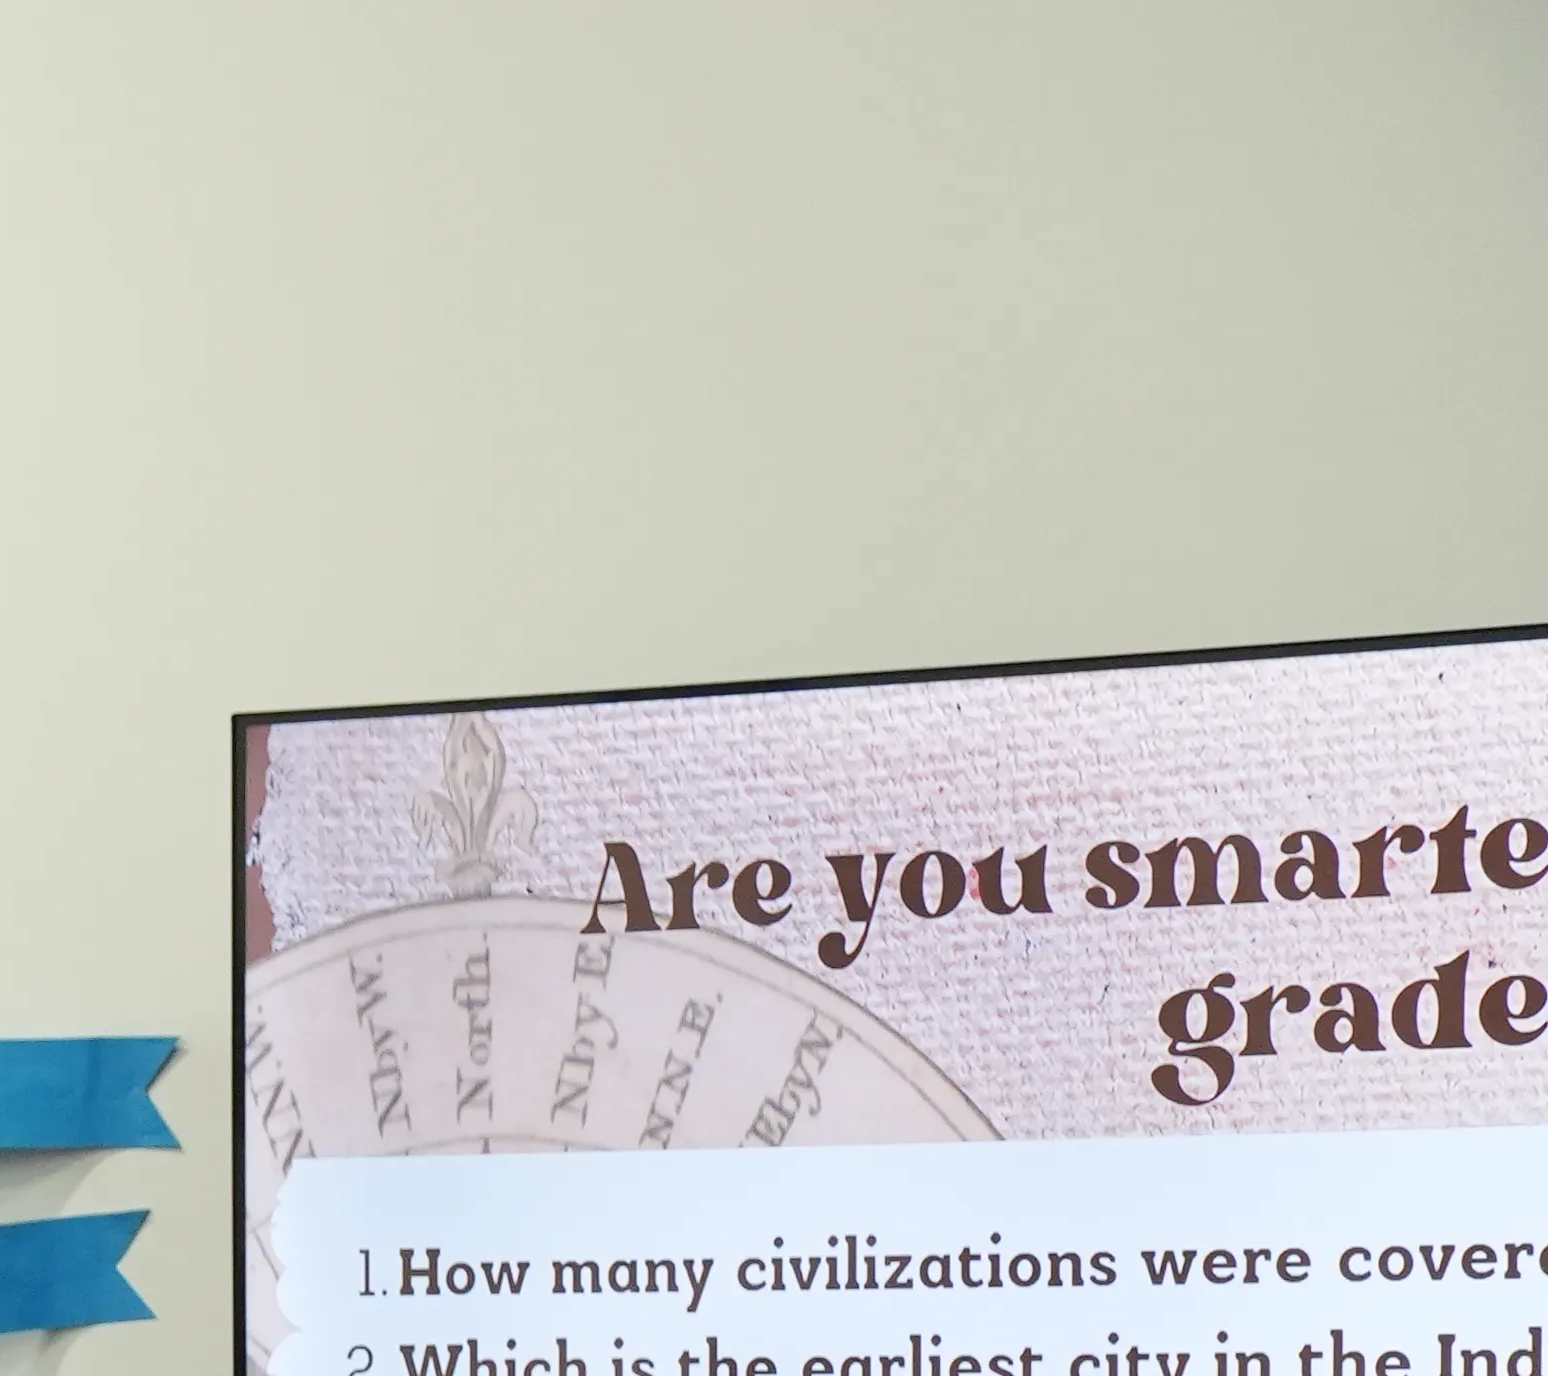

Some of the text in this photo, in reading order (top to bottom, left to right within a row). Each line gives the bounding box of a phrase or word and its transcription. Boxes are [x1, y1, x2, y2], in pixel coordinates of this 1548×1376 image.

[581, 805, 1548, 969] Are you smarte
[1151, 951, 1548, 1105] grade
[360, 1233, 1548, 1312] 1. How many civilizations were cover
